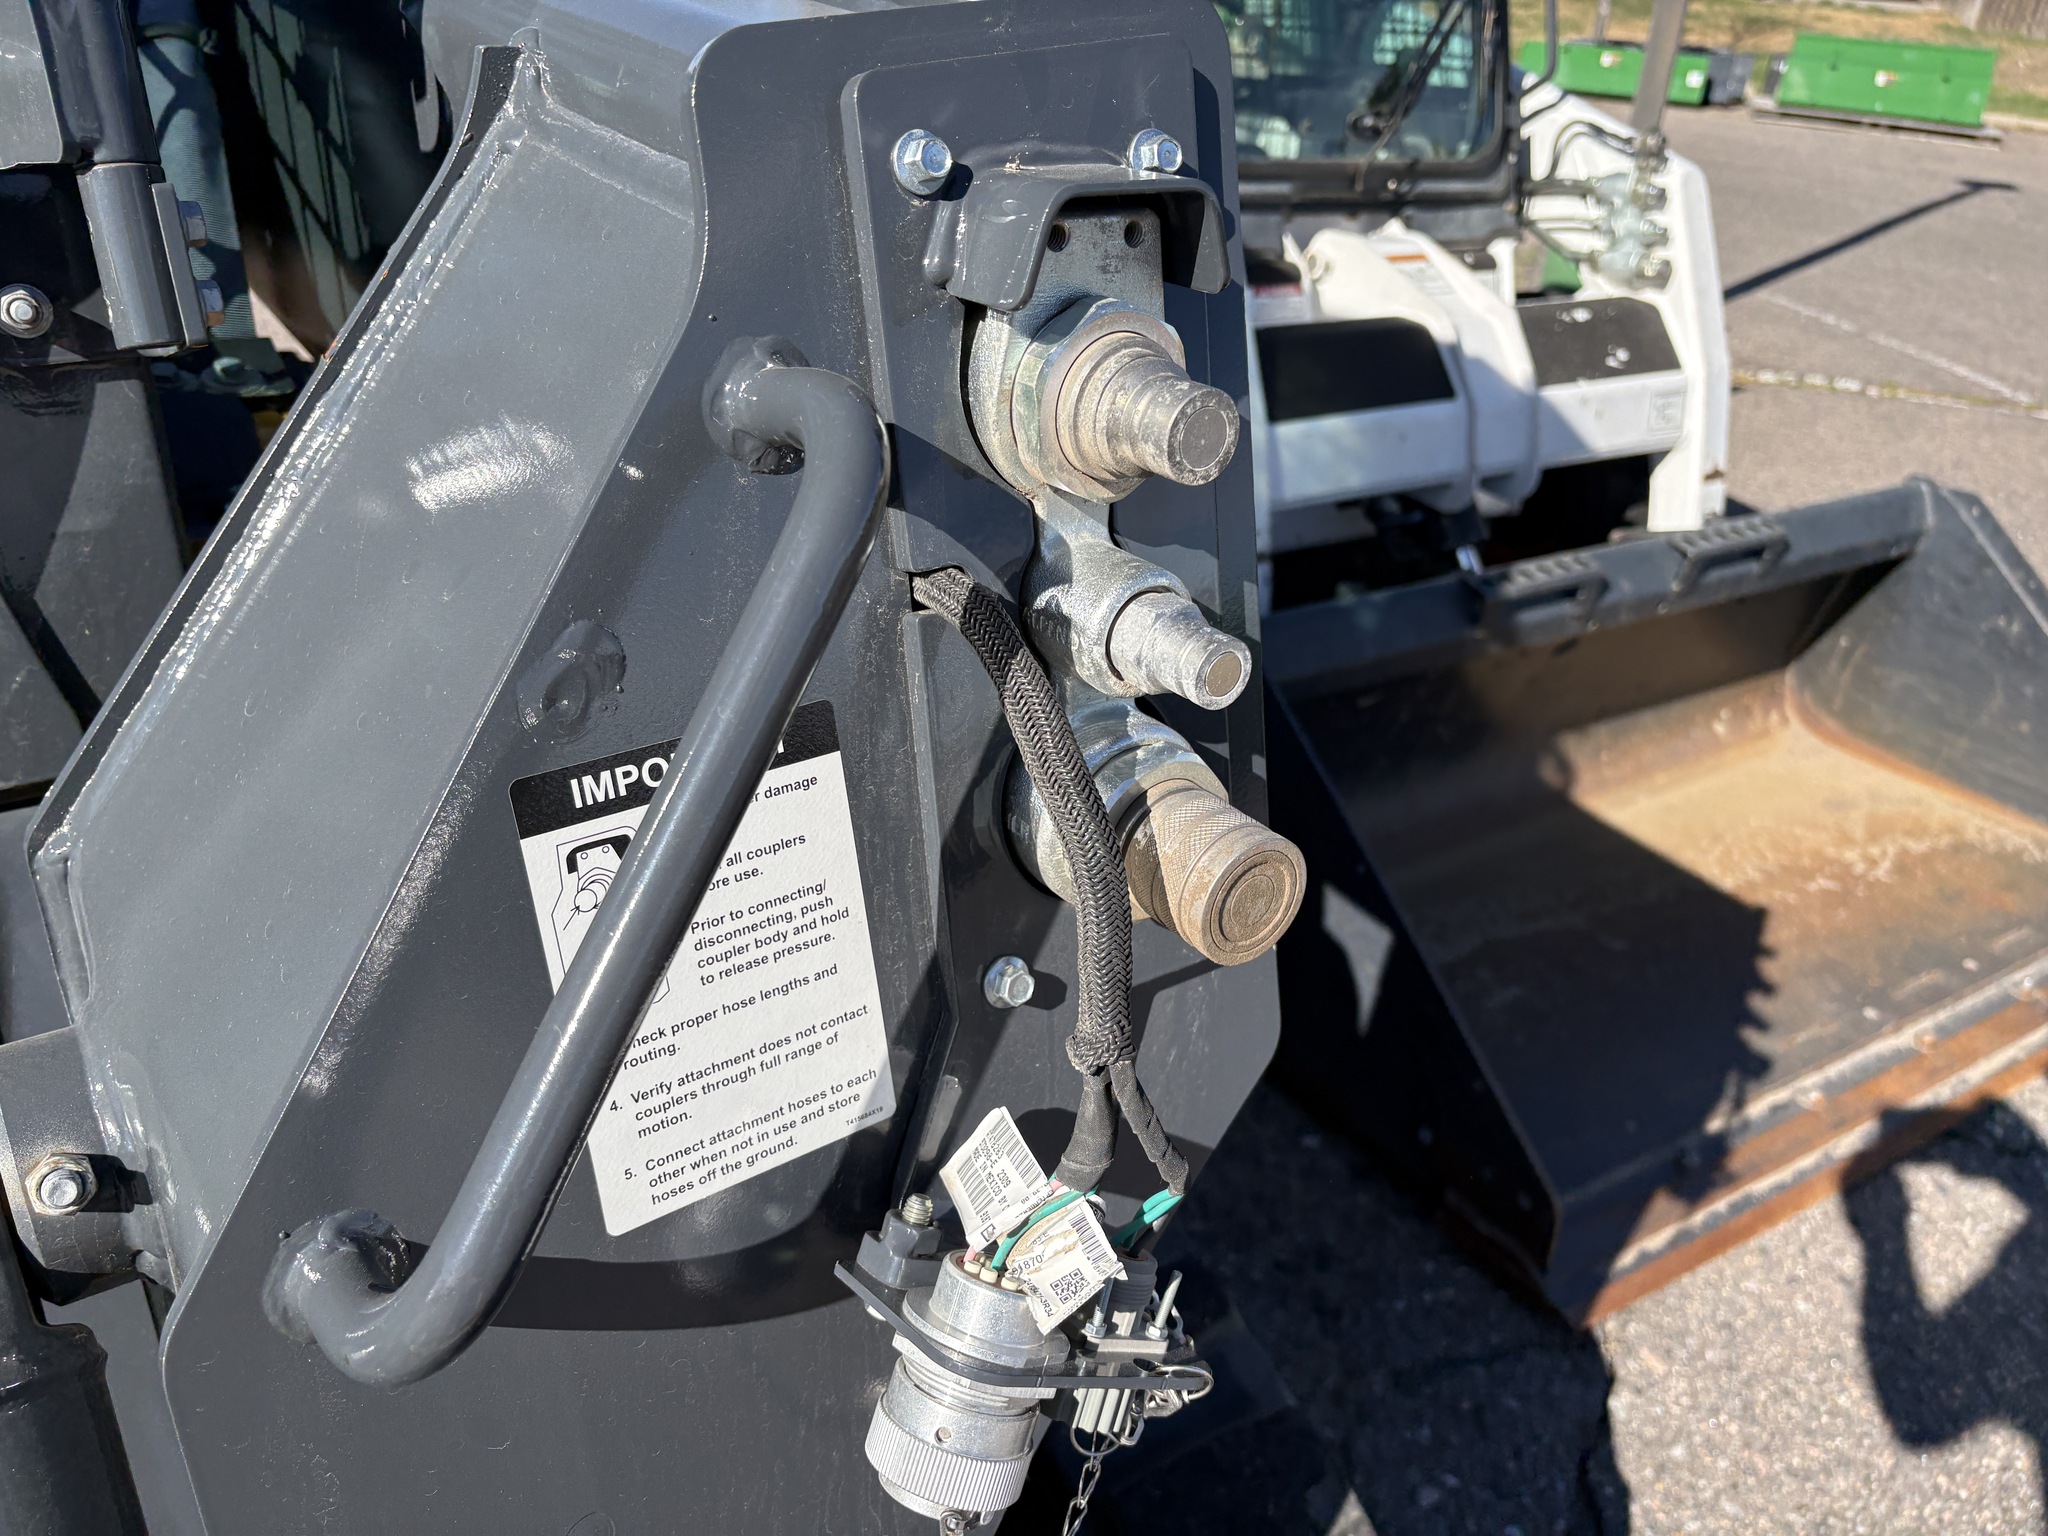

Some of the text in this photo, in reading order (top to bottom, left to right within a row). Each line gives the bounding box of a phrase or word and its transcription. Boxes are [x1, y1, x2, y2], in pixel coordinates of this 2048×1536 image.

[570, 755, 672, 809] IMPO
[764, 776, 818, 799] damage
[726, 835, 806, 867] all couplers
[691, 879, 826, 935] Prior to connecting/
[709, 868, 764, 891] ore use.
[694, 896, 833, 952] disconnecting, push
[697, 906, 849, 969] coupler body and hold
[700, 933, 835, 986] to release pressure.
[633, 963, 838, 1049] heck proper hose lengths and
[610, 1005, 868, 1112] 4. Verify attachment does not contact
[624, 1043, 681, 1070] routing.
[635, 1031, 838, 1121] couplers through full range of
[625, 1069, 877, 1180] 5. Connect attachment hoses to each
[638, 1112, 692, 1139] motion.
[649, 1093, 860, 1188] other when not in use and store
[651, 1136, 798, 1205] hoses off the ground.
[980, 1161, 988, 1173] IN
[985, 1171, 1002, 1197] MEXICO
